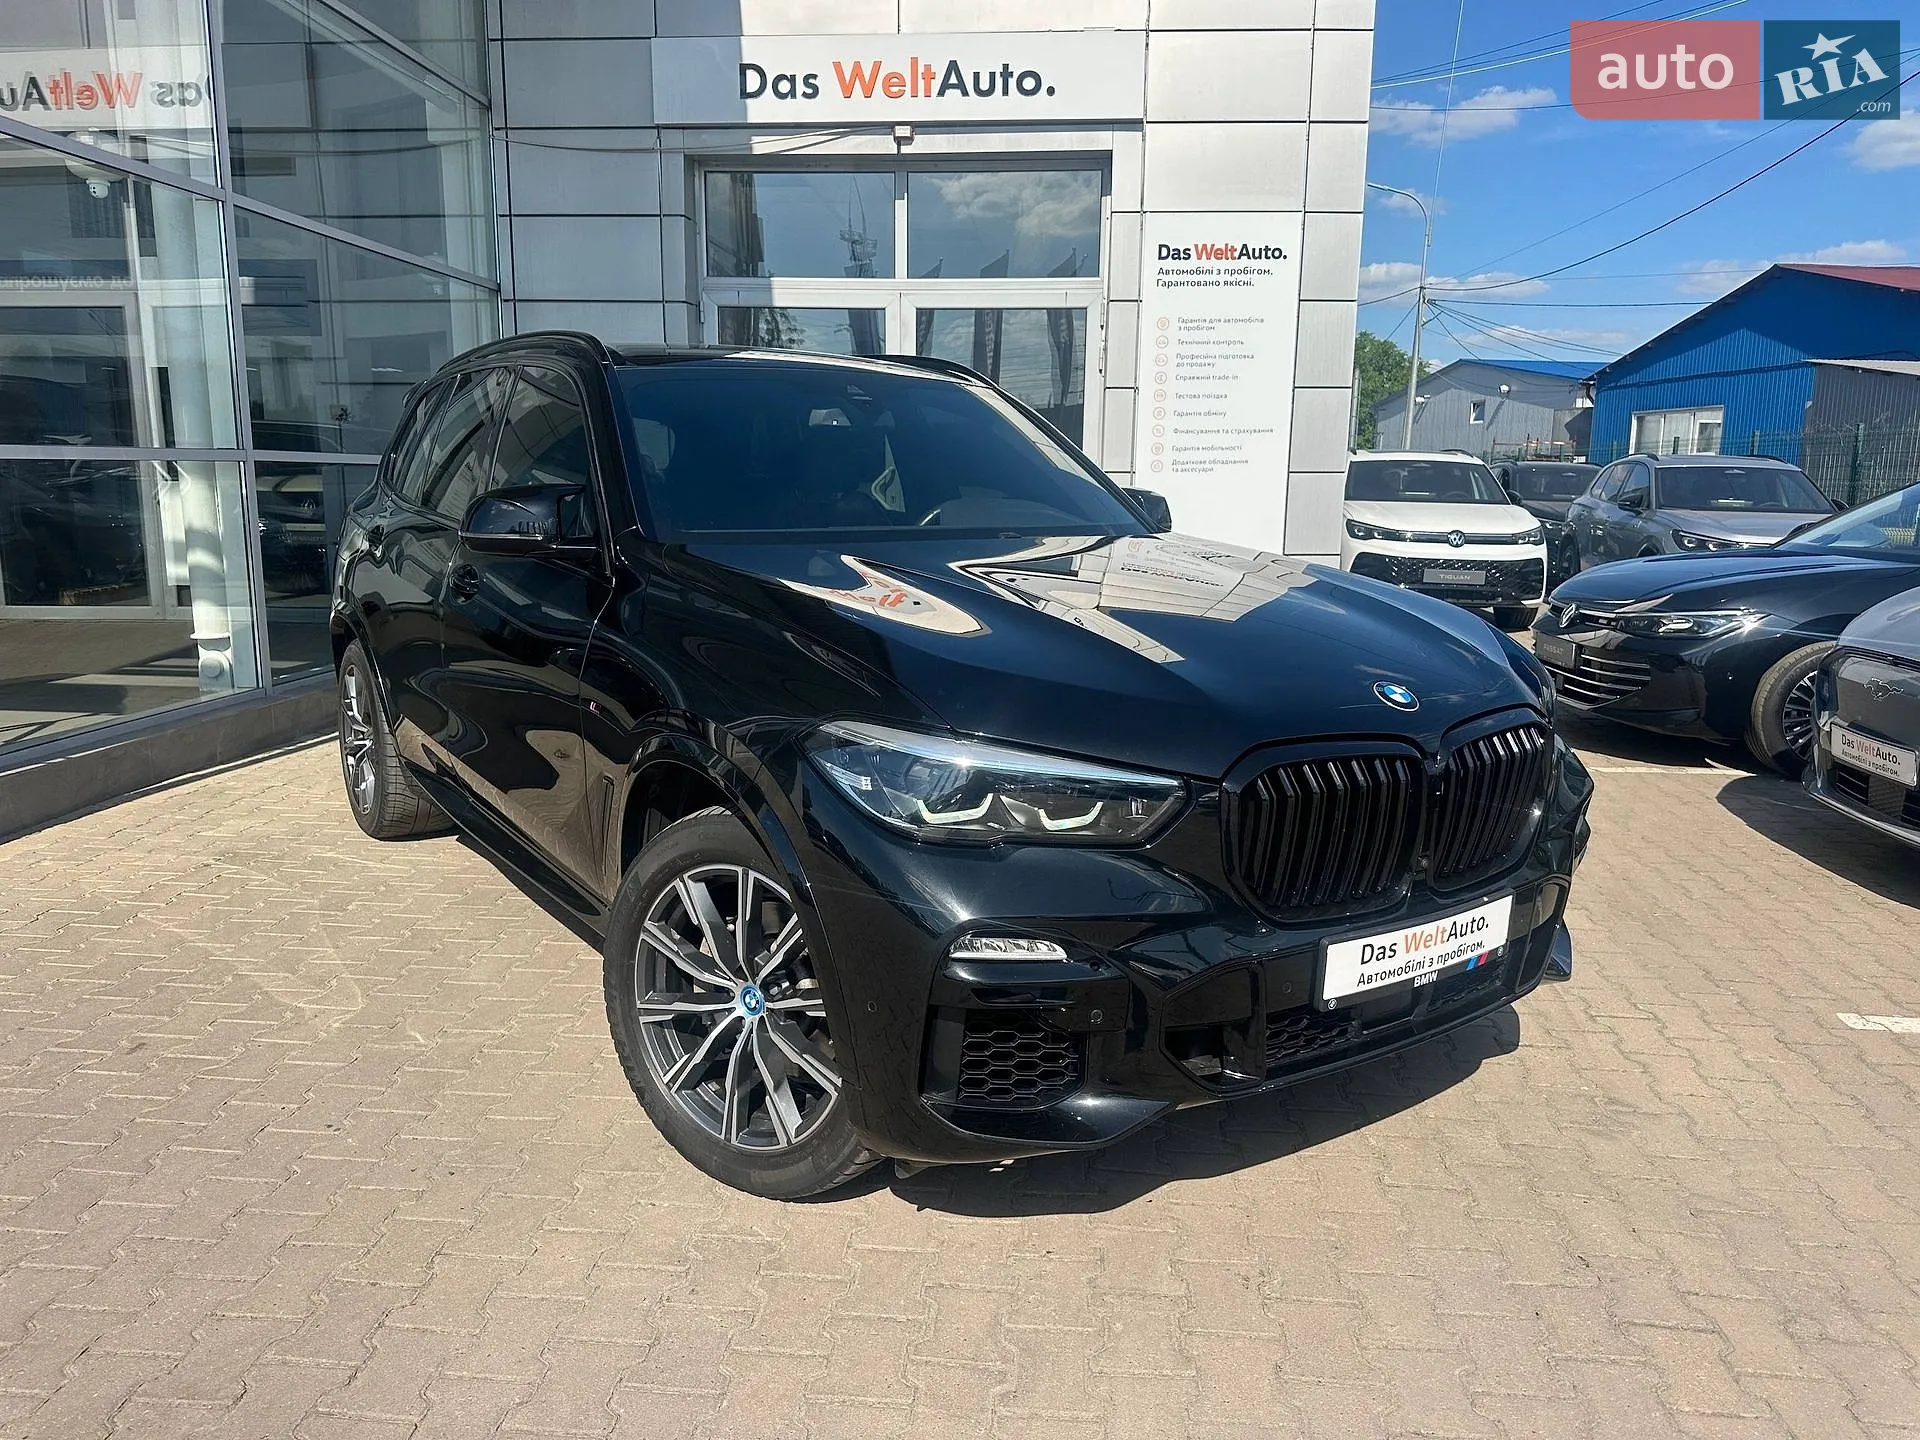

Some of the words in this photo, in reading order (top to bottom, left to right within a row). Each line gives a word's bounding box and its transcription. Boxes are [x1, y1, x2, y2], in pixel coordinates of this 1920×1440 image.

[739, 63, 820, 99] Das
[832, 57, 1056, 98] WeltAuto.
[1158, 244, 1191, 261] Das
[1194, 243, 1287, 260] WeltAuto.
[1157, 279, 1221, 289] Гарантовано
[1223, 278, 1255, 287] якісні.
[1158, 267, 1214, 276] Автомобілі
[1224, 267, 1273, 277] пробігом.
[1841, 733, 1854, 749] Das
[1856, 740, 1900, 765] WeltAuto.
[1360, 942, 1398, 965] Das
[1403, 915, 1489, 955] WeltAuto.
[1357, 960, 1426, 988] Автомобілі
[1428, 957, 1434, 968] з
[1436, 940, 1486, 966] пробігом.
[1413, 970, 1440, 988] BMW
